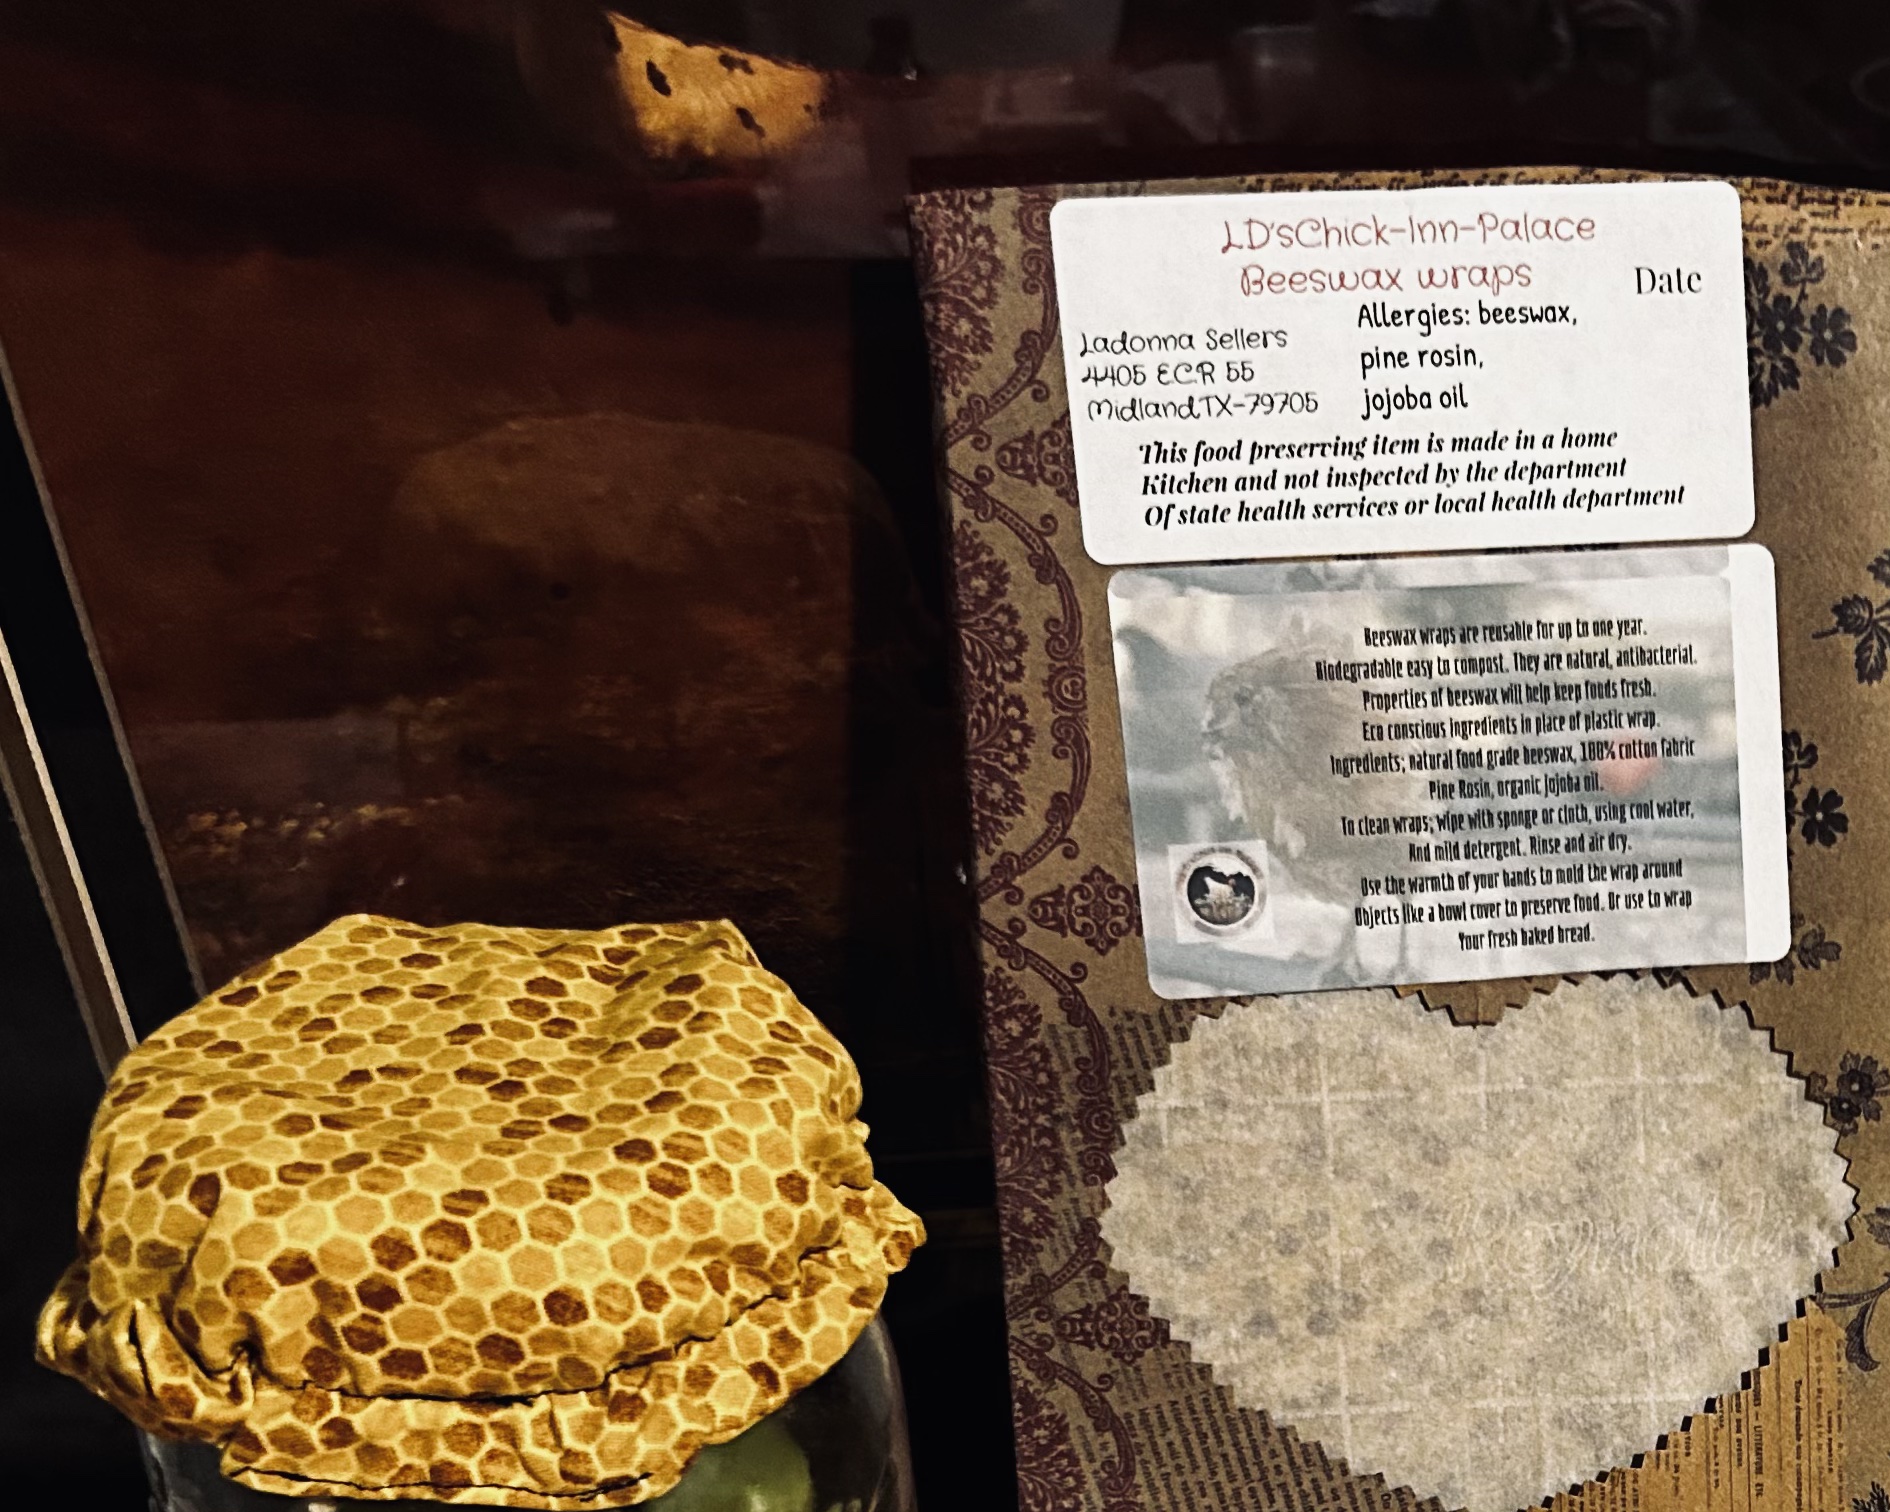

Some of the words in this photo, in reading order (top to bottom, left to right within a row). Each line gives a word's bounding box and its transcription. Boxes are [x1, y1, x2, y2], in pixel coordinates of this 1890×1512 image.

[1240, 264, 1403, 296] Beeswax
[1417, 263, 1532, 296] wraps
[1634, 266, 1702, 295] Date
[1358, 301, 1471, 337] Allergies:
[1478, 299, 1577, 326] beeswax,
[1079, 330, 1195, 357] Ladonna
[1205, 328, 1288, 351] Sellers
[1081, 364, 1146, 387] 4405
[1157, 361, 1215, 386] ECR
[1226, 360, 1255, 382] 55
[1360, 345, 1410, 380] pine
[1418, 343, 1484, 369] rosin,
[1361, 384, 1432, 421] jojoba
[1439, 382, 1469, 409] oil
[1139, 440, 1188, 465] This
[1193, 439, 1243, 467] food
[1249, 435, 1368, 465] preserving
[1372, 434, 1420, 457] item
[1427, 431, 1445, 454] is
[1451, 429, 1509, 453] made
[1515, 428, 1536, 450] in
[1541, 433, 1554, 450] a
[1561, 426, 1618, 449] home
[1141, 472, 1228, 496] Kitchen
[1234, 468, 1277, 492] and
[1284, 468, 1320, 490] not
[1326, 463, 1429, 491] inspected
[1435, 462, 1460, 488] by
[1466, 460, 1499, 484] the
[1503, 457, 1627, 485] department
[1177, 504, 1231, 525] state
[1237, 498, 1306, 522] health
[1312, 495, 1399, 519] services
[1404, 499, 1430, 516] or
[1434, 490, 1487, 514] local
[1491, 487, 1556, 512] health
[1562, 485, 1685, 513] department
[1363, 626, 1417, 647] Beeswax
[1419, 625, 1456, 647] wraps
[1459, 625, 1479, 644] are
[1482, 620, 1533, 642] reusable
[1536, 619, 1554, 640] for
[1558, 621, 1572, 642] up
[1576, 617, 1589, 638] to
[1592, 618, 1613, 637] one
[1616, 618, 1648, 640] year.
[1315, 657, 1403, 683] Biodegradable
[1407, 659, 1434, 680] easy
[1437, 655, 1450, 676] to
[1454, 653, 1510, 677] compost.
[1513, 651, 1540, 675] They
[1543, 652, 1563, 671] are
[1566, 648, 1613, 670] natural,
[1616, 643, 1698, 667] antibacterial.
[1362, 688, 1428, 713] Properties
[1431, 687, 1443, 707] of
[1447, 686, 1499, 707] beeswax
[1501, 683, 1523, 705] will
[1525, 681, 1551, 705] help
[1554, 681, 1582, 703] keep
[1585, 679, 1618, 700] foods
[1620, 677, 1657, 698] fresh.
[1362, 721, 1384, 741] Eco
[1387, 719, 1447, 741] conscious
[1449, 714, 1517, 740] ingredients
[1520, 713, 1532, 734] in
[1535, 711, 1566, 737] place
[1569, 710, 1581, 731] of
[1584, 709, 1624, 733] plastic
[1627, 709, 1661, 730] wrap.
[1409, 749, 1453, 771] natural
[1456, 747, 1483, 768] food
[1486, 746, 1519, 770] grade
[1522, 745, 1577, 765] beeswax,
[1580, 740, 1616, 762] 100%
[1618, 739, 1658, 760] cotton
[1660, 736, 1695, 758] fabric
[1428, 780, 1455, 800] Pine
[1458, 778, 1495, 800] Rosin,
[1497, 775, 1541, 799] organic
[1584, 771, 1604, 793] oil.
[1341, 816, 1355, 836] To
[1358, 815, 1390, 836] clean
[1437, 810, 1464, 834] wipe
[1468, 809, 1494, 830] with
[1497, 809, 1538, 831] sponge
[1541, 808, 1555, 825] or
[1558, 804, 1592, 825] cloth,
[1595, 802, 1627, 823] using
[1630, 799, 1654, 820] cool
[1657, 798, 1694, 820] water,
[1409, 843, 1431, 862] And
[1434, 841, 1460, 861] mild
[1464, 838, 1526, 861] detergent.
[1530, 835, 1561, 856] Rinse
[1564, 833, 1585, 854] and
[1589, 832, 1605, 852] air
[1608, 832, 1633, 854] dry.
[1361, 876, 1381, 896] Use
[1385, 875, 1405, 895] the
[1408, 872, 1455, 894] warmth
[1458, 871, 1471, 891] of
[1473, 872, 1500, 893] your
[1503, 867, 1537, 888] hands
[1540, 866, 1552, 885] to
[1556, 864, 1584, 884] mold
[1588, 862, 1607, 882] the
[1610, 863, 1638, 883] wrap
[1642, 858, 1683, 880] around
[1355, 905, 1400, 929] Objects
[1403, 902, 1424, 924] like
[1428, 906, 1435, 922] a
[1438, 902, 1467, 922] bowl
[1470, 901, 1501, 920] cover
[1505, 899, 1517, 917] to
[1521, 896, 1571, 919] preserve
[1573, 892, 1605, 913] food.
[1608, 892, 1621, 910] Or
[1624, 892, 1644, 910] use
[1648, 889, 1661, 908] to
[1664, 889, 1692, 910] wrap
[1458, 931, 1485, 951] Your
[1488, 929, 1518, 948] fresh
[1521, 925, 1554, 946] baked
[1557, 922, 1595, 943] bread.
